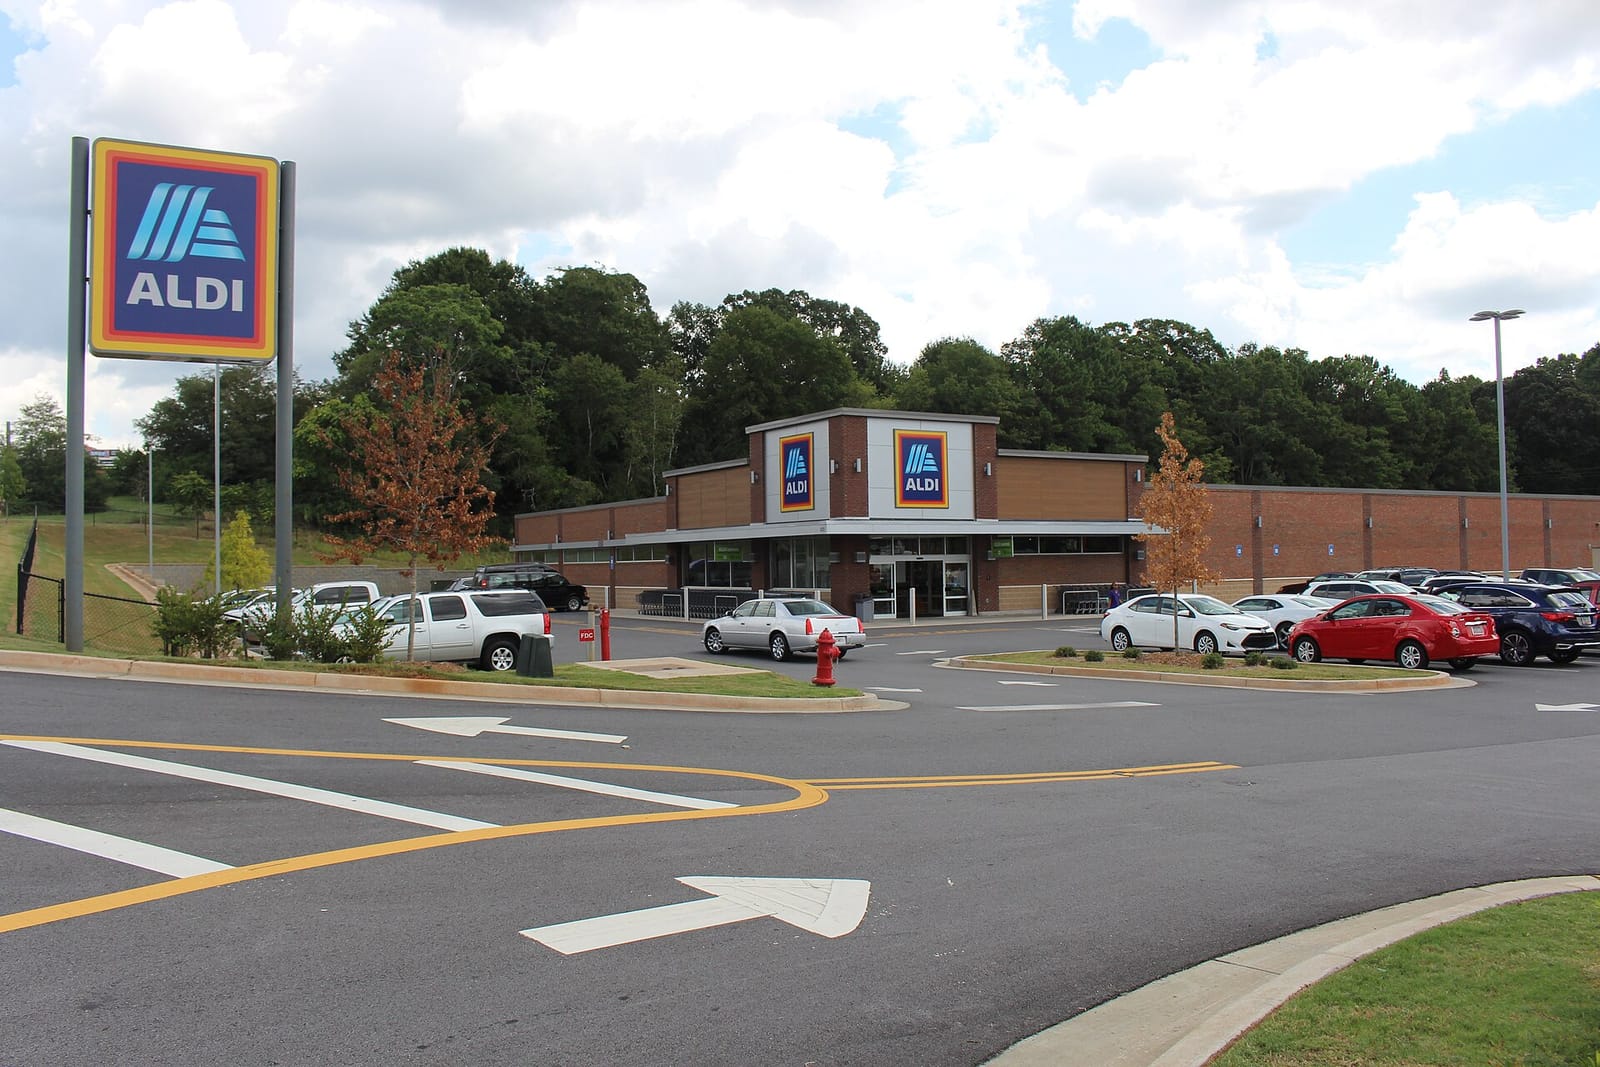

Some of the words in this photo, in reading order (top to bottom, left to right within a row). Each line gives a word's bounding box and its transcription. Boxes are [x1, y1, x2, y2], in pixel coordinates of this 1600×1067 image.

[126, 272, 243, 311] ALDI
[786, 480, 807, 495] ALDI
[905, 477, 939, 491] ALDI
